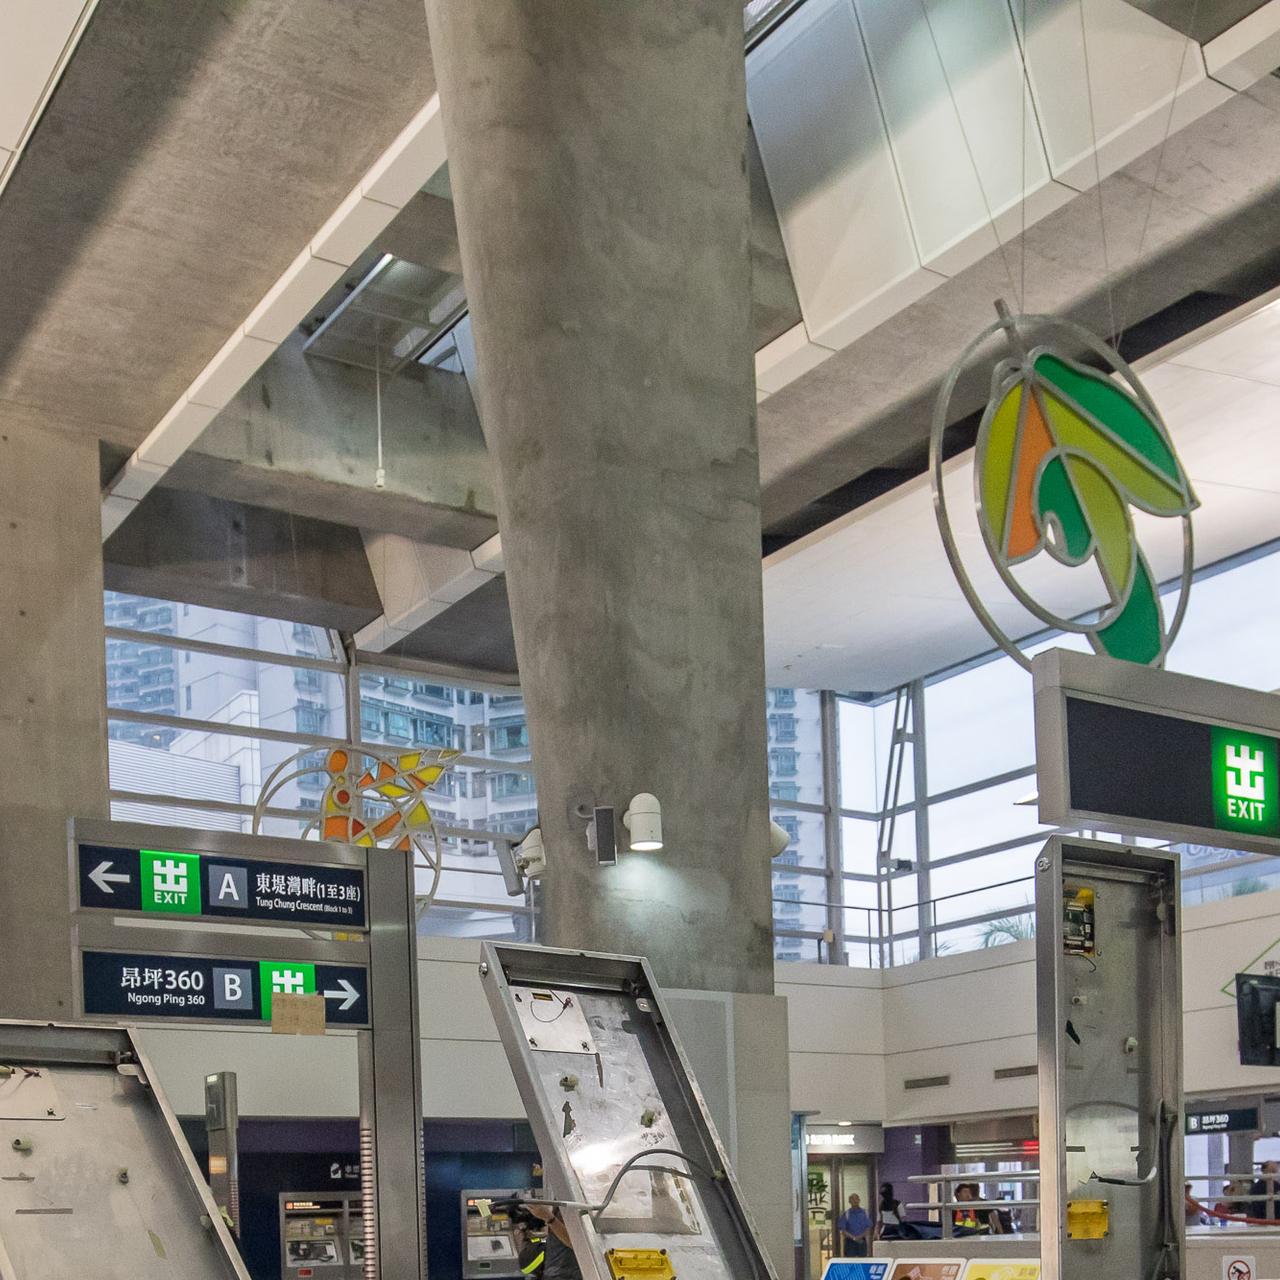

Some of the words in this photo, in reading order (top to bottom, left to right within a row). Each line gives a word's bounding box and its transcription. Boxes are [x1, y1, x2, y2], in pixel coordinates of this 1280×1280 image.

[1226, 798, 1265, 822] EXIT
[154, 891, 187, 905] EXIT
[218, 872, 239, 901] A
[256, 897, 273, 910] Tung
[274, 898, 295, 911] Chung
[296, 900, 323, 912] Crescent
[121, 967, 204, 991] 昂坪360
[224, 973, 242, 1001] B
[127, 992, 162, 1006] Ngong
[163, 995, 185, 1006] Ping
[187, 995, 205, 1005] 360
